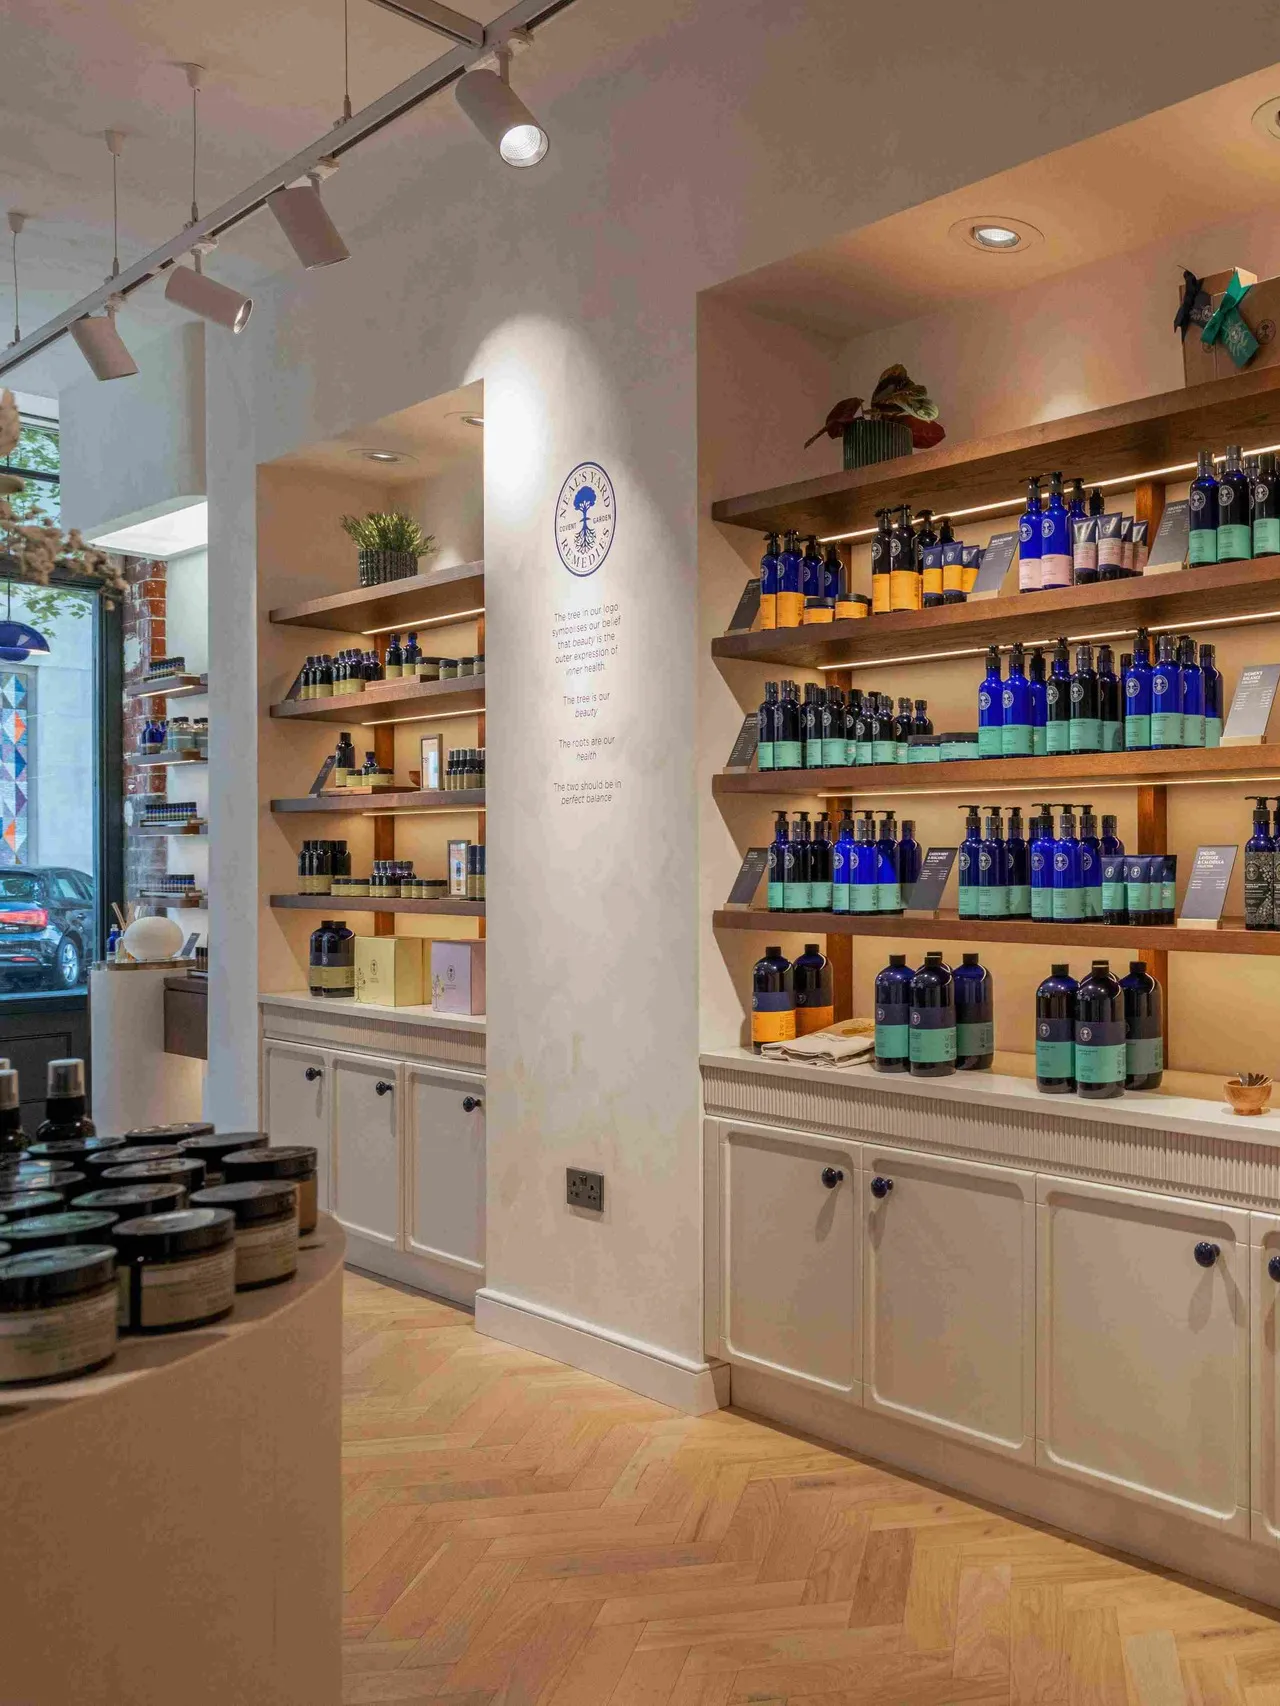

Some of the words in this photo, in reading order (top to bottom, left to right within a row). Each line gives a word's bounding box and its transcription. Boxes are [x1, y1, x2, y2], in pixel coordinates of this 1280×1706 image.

[560, 471, 587, 519] NEAL'S
[590, 471, 611, 508] YARD
[559, 522, 577, 533] COVENT
[592, 514, 612, 524] GARDEN
[561, 527, 610, 569] REMEDIES
[554, 612, 566, 623] The
[568, 610, 581, 620] tree
[583, 608, 589, 617] in
[590, 606, 602, 616] our
[603, 603, 619, 615] logo
[552, 623, 587, 638] symbolises
[588, 621, 601, 631] our
[602, 615, 622, 628] belief
[557, 639, 571, 650] that
[572, 635, 595, 647] beauty
[596, 634, 602, 643] is
[603, 632, 616, 642] the
[555, 653, 572, 664] outer
[573, 648, 610, 662] expression
[611, 644, 619, 655] of
[565, 666, 583, 677] inner
[563, 696, 575, 706] The
[577, 695, 590, 704] tree
[592, 692, 597, 702] is
[599, 692, 610, 701] our
[575, 708, 598, 721] beauty
[559, 739, 571, 749] The
[572, 738, 589, 748] roots
[591, 737, 602, 746] are
[603, 736, 616, 745] our
[576, 751, 597, 762] health
[554, 782, 565, 792] The
[567, 783, 579, 791] two
[580, 780, 603, 790] should
[604, 779, 614, 789] be
[615, 779, 622, 788] in
[561, 794, 585, 806] perfect
[586, 793, 612, 803] balance
